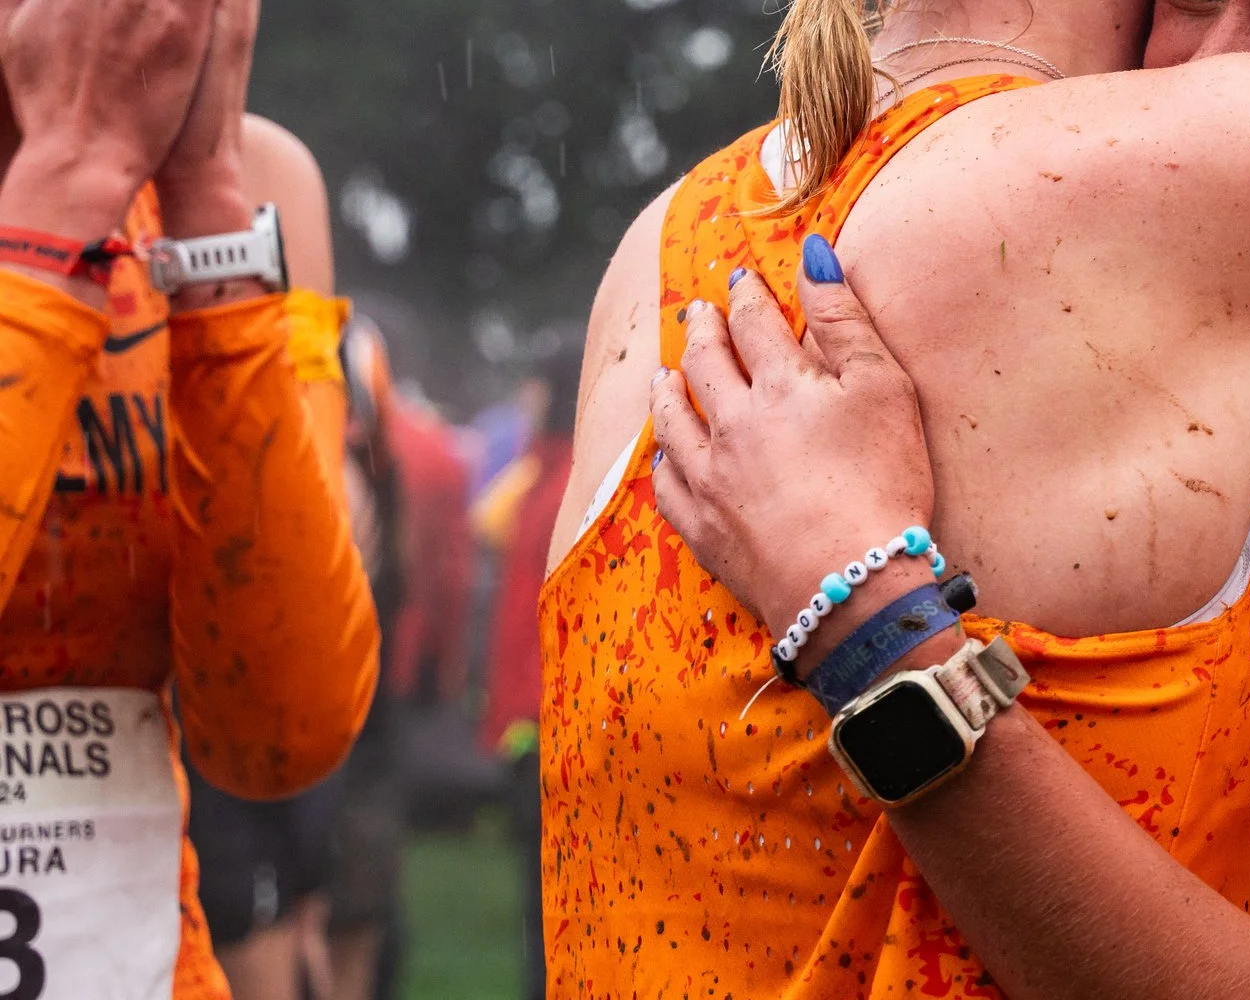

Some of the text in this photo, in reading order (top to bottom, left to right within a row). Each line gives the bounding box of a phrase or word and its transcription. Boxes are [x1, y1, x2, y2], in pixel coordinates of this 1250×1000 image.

[871, 600, 938, 650] CRSS
[0, 700, 115, 737] ROSS
[0, 742, 112, 778] NALS
